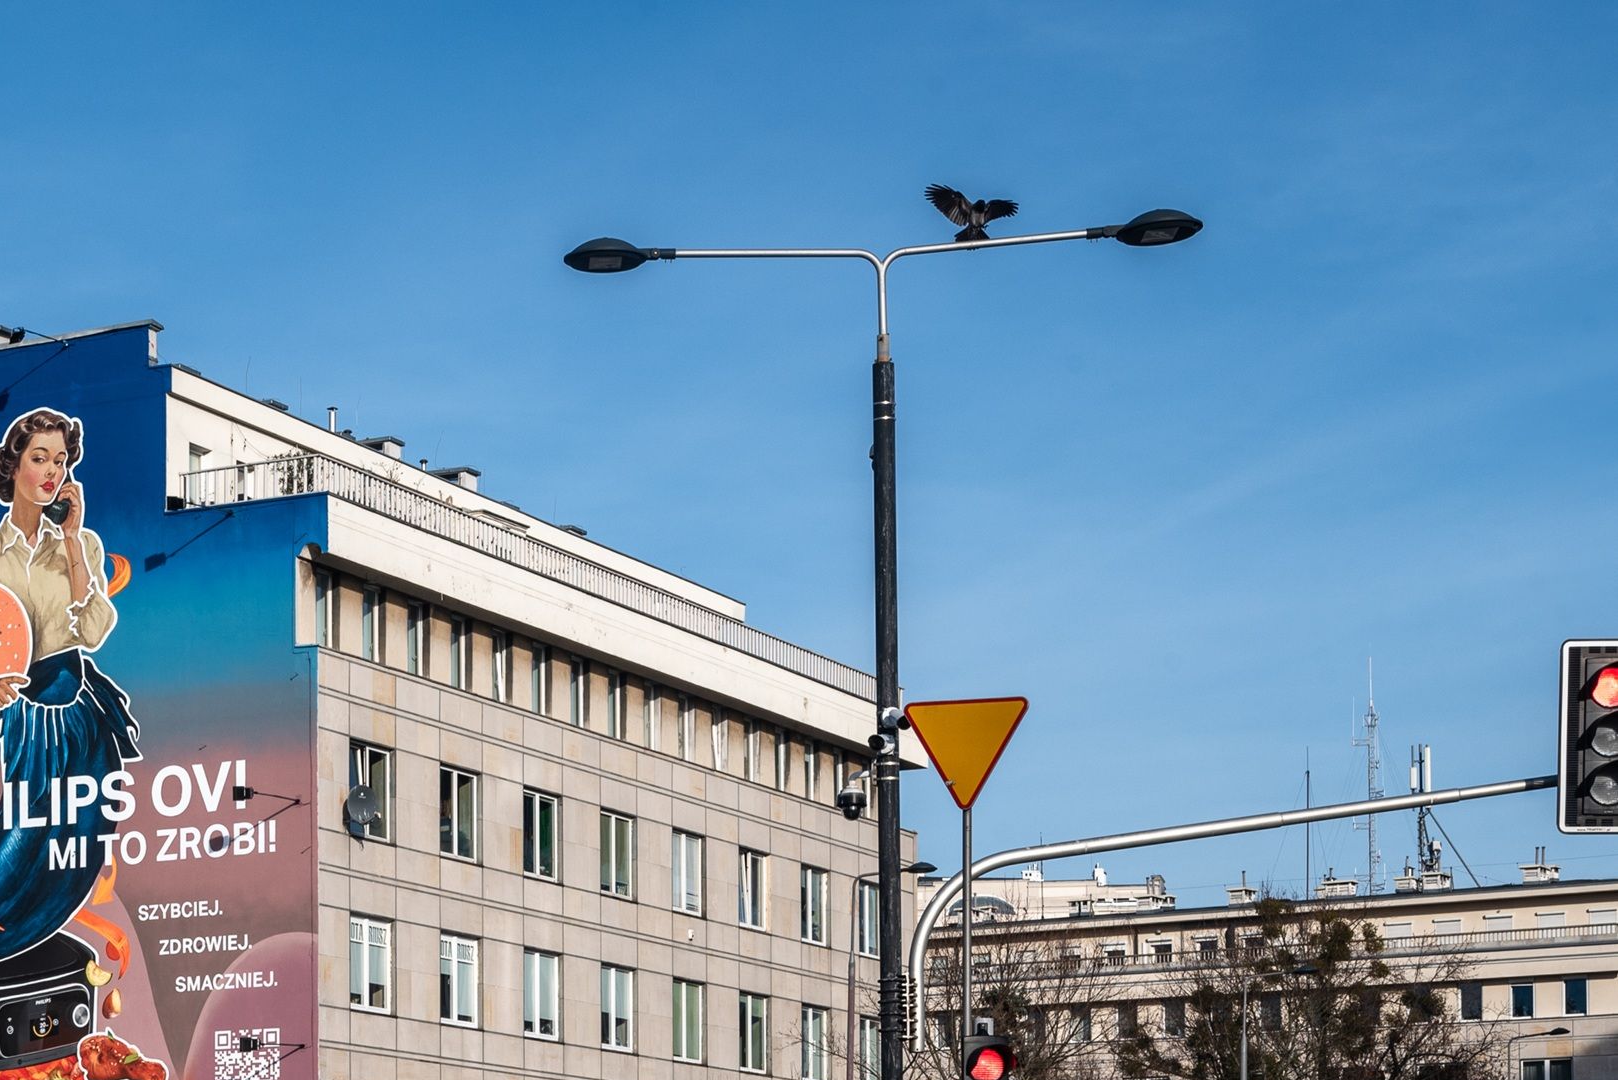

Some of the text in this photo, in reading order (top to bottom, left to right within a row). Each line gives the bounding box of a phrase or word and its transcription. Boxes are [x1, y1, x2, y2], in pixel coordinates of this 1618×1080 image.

[151, 759, 247, 817] OV!
[48, 819, 277, 871] MI TO ZROBI!
[137, 900, 224, 922] SZYBCIEJ.
[159, 934, 252, 956] ZDROWIEJ.
[175, 971, 278, 993] SMACZNIEJ.
